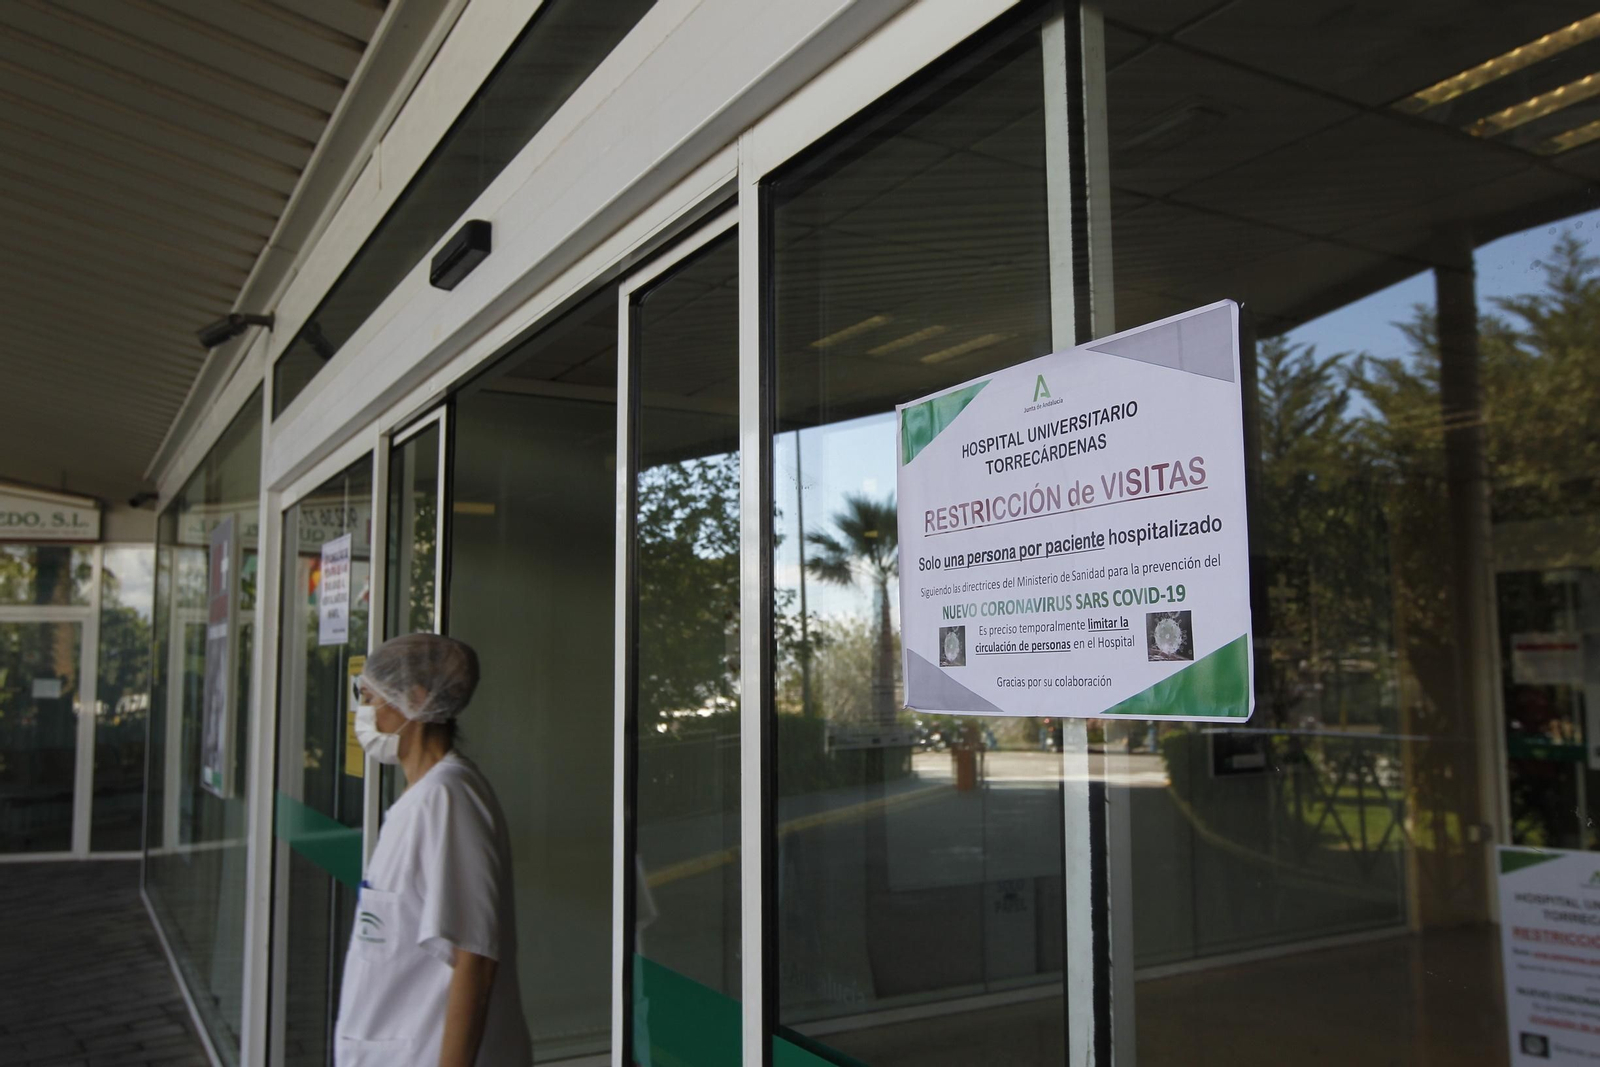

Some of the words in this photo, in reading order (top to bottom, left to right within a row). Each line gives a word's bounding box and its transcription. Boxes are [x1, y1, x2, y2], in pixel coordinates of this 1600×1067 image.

[1023, 403, 1036, 413] Junta
[1042, 397, 1064, 409] Andalucía
[961, 431, 1025, 459] HOSPITAL
[1027, 401, 1138, 443] UNIVERSITARIO
[985, 433, 1107, 475] TORRECÁRDENAS
[924, 482, 1062, 533] RESTRICCIÓN
[1067, 480, 1095, 507] de
[1100, 456, 1208, 500] VISITAS
[918, 555, 941, 572] Solo
[943, 554, 965, 569] una
[966, 547, 1017, 569] persona
[1019, 543, 1043, 562] por
[1045, 531, 1106, 560] paciente
[1108, 514, 1223, 547] hospitalizado
[920, 584, 952, 600] Siguiendo
[952, 583, 961, 594] las
[961, 579, 1001, 593] directrices
[1002, 577, 1015, 589] del
[1017, 572, 1059, 587] Ministerio
[1060, 571, 1071, 583] de
[1071, 566, 1106, 582] Sanidad
[1107, 565, 1129, 580] para
[1130, 563, 1140, 575] la
[1142, 556, 1202, 577] prevención
[1204, 553, 1221, 568] del
[942, 602, 978, 620] NUEVO
[980, 594, 1073, 618] CORONAVIRUS
[1075, 590, 1110, 611] SARS
[1112, 584, 1187, 608] COVID-19
[975, 640, 1017, 653] circulación
[1018, 640, 1030, 651] de
[1031, 640, 1072, 653] personas
[1073, 640, 1085, 650] en
[1087, 636, 1096, 649] el
[1097, 635, 1136, 651] Hospital
[978, 625, 988, 636] Es
[989, 624, 1018, 638] preciso
[1019, 620, 1086, 636] temporalmente
[1087, 617, 1118, 630] limitar
[1120, 616, 1129, 628] la
[996, 676, 1026, 688] Gracias
[1027, 678, 1042, 691] por
[1043, 678, 1053, 688] su
[1054, 675, 1113, 688] colaboración
